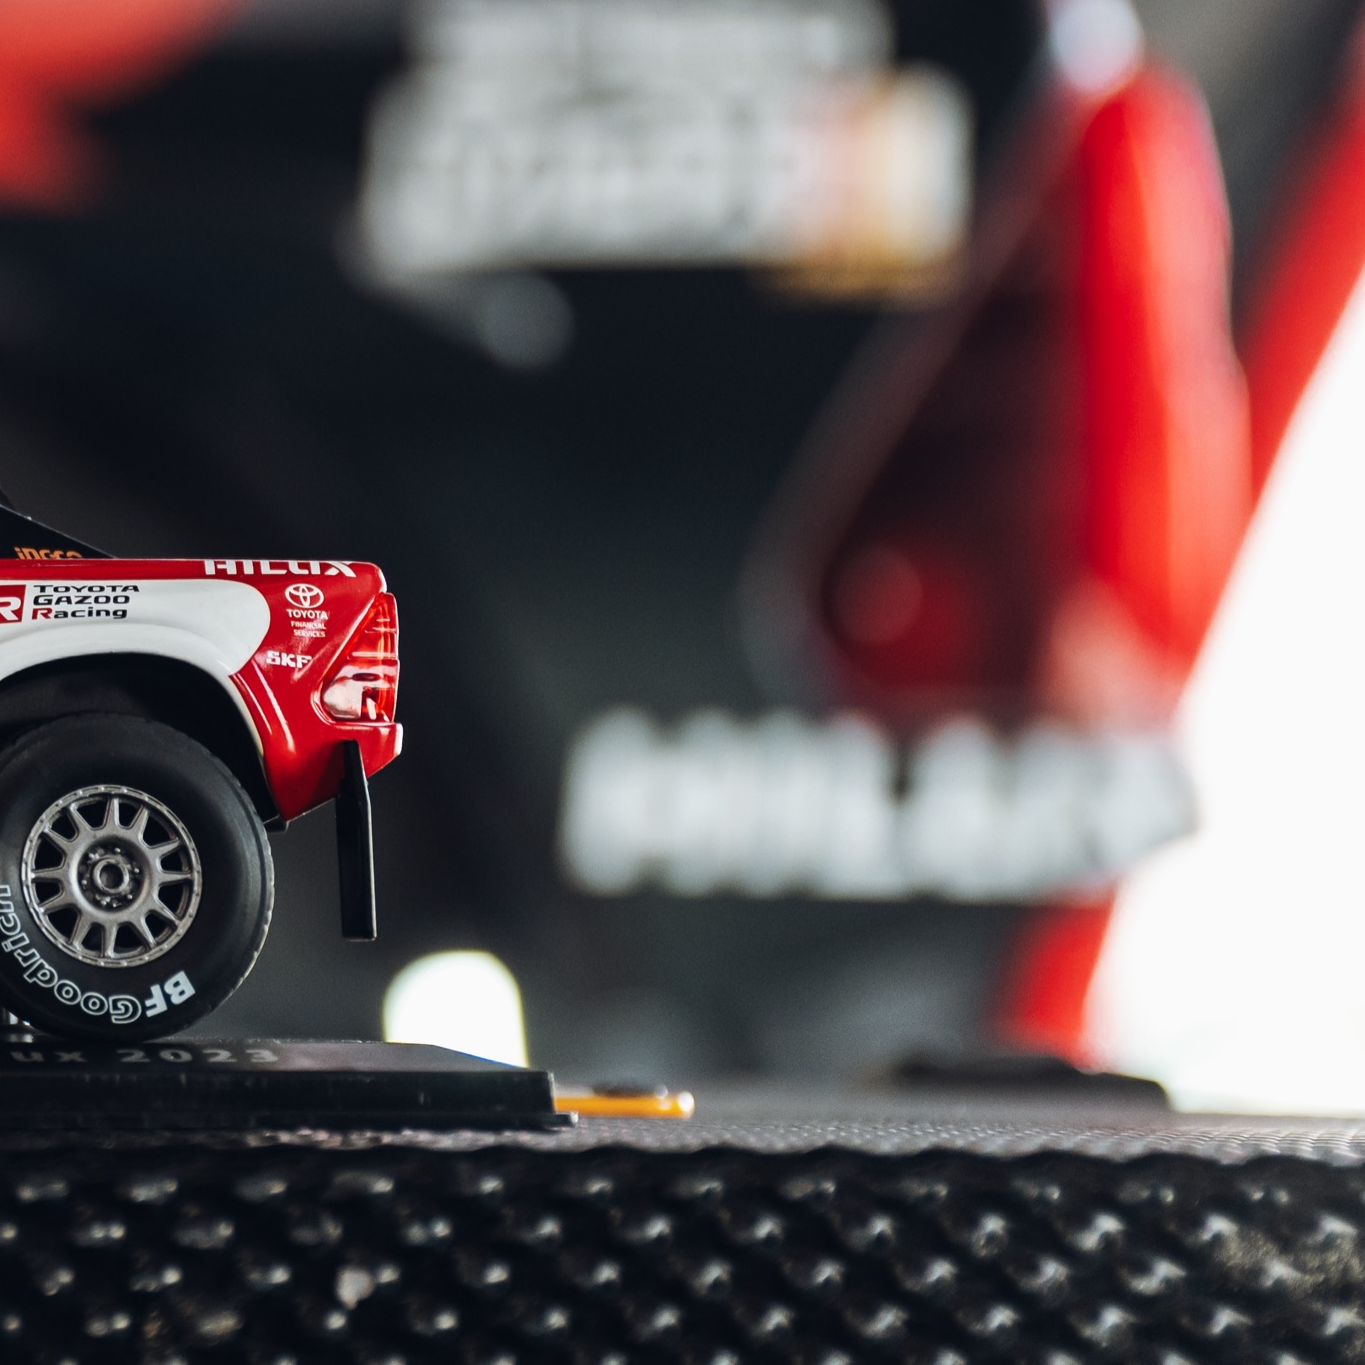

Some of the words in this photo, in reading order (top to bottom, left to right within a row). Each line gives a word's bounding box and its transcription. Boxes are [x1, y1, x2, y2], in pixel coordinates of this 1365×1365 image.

[33, 584, 140, 593] TOYOTA
[32, 594, 131, 606] GAZOO
[31, 606, 128, 620] Racing
[286, 608, 329, 620] TOYOTA
[290, 620, 326, 630] FINANCIAL
[293, 629, 326, 638] SERVICES
[266, 650, 312, 668] SKF
[116, 1046, 279, 1065] 2023
